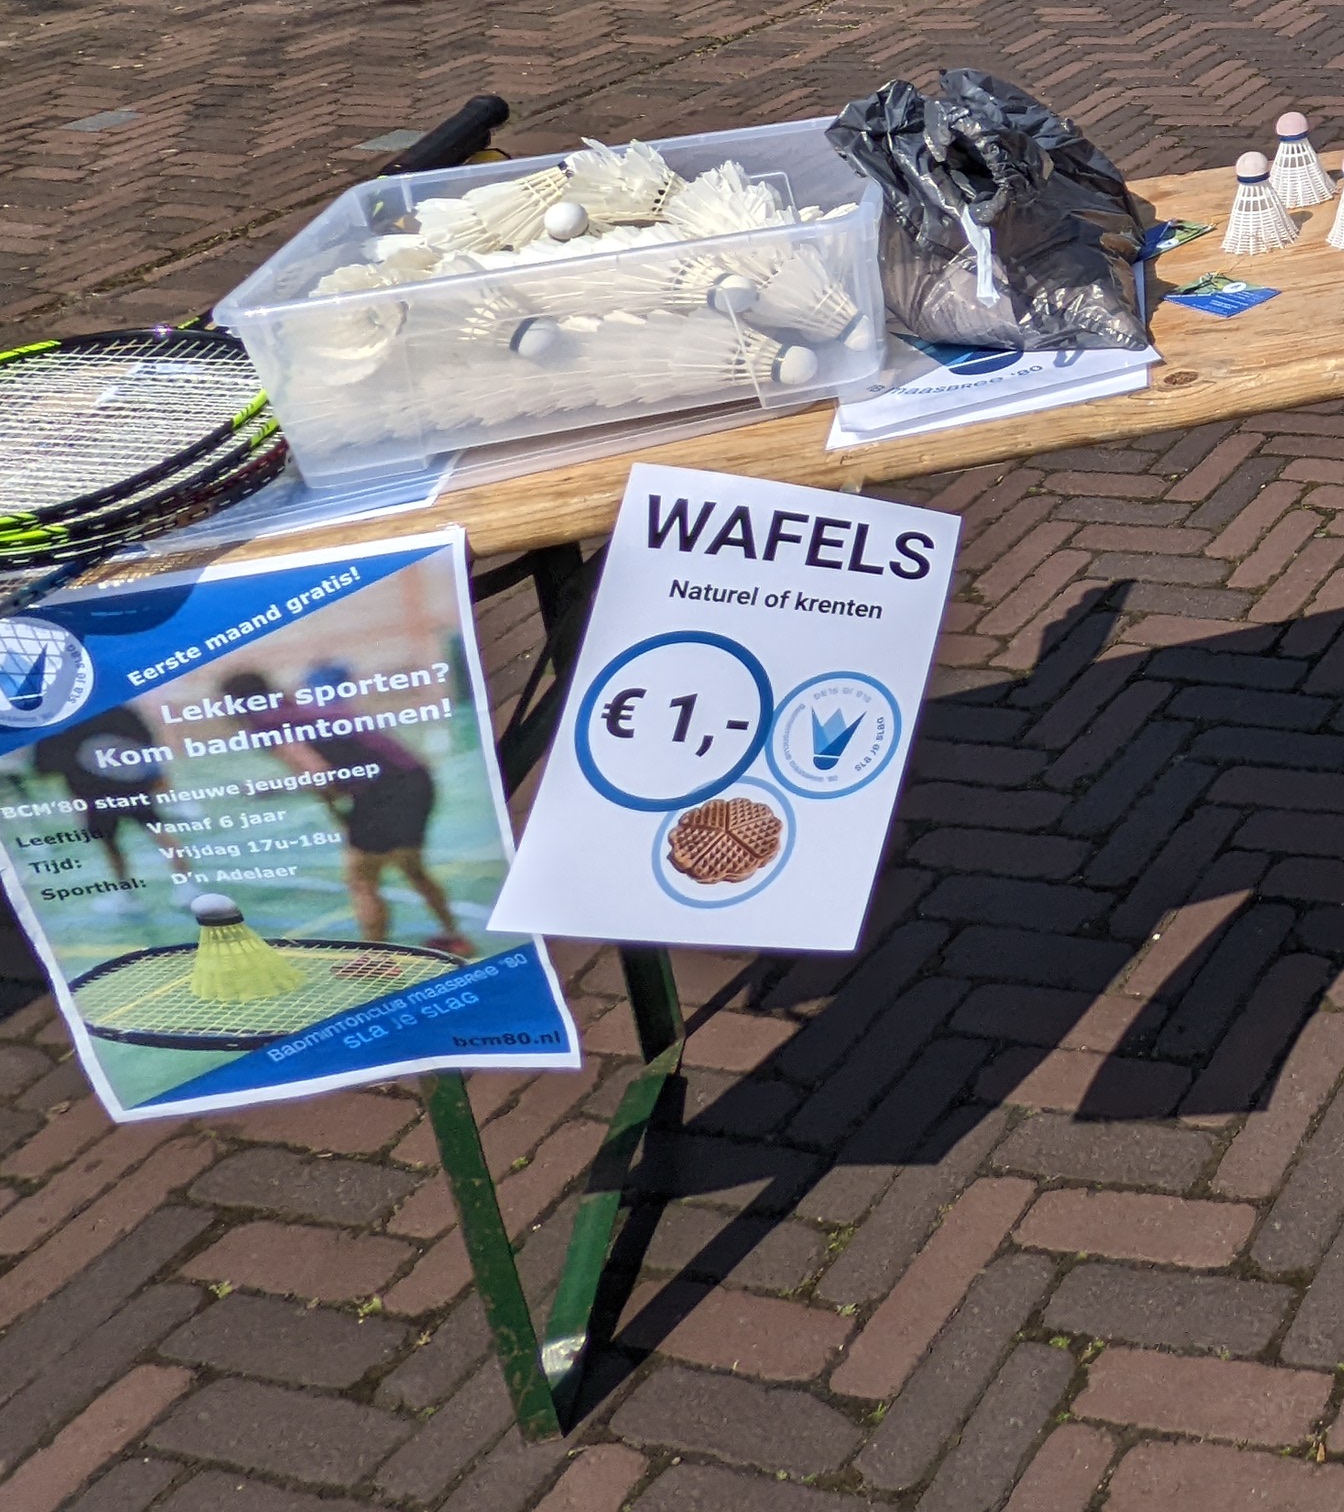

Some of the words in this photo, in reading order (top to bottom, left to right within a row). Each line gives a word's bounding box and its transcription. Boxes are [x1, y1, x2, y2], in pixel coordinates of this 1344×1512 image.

[646, 494, 936, 580] WAFELS
[668, 579, 758, 607] Naturel
[764, 590, 793, 610] of
[794, 592, 884, 620] krenten
[127, 643, 202, 687] Eerste
[205, 605, 282, 650] maand
[286, 566, 361, 615] gratis!
[160, 691, 284, 724] Lekker
[295, 662, 449, 706] sporten?
[600, 687, 647, 738] €
[95, 745, 173, 769] Kom
[185, 698, 453, 758] badmintonnen!
[94, 793, 151, 810] start
[156, 783, 240, 804] nieuwe
[245, 762, 381, 797] jeugdgroep
[147, 818, 212, 835] Vanaf
[219, 815, 234, 829] 6
[240, 808, 288, 830] jaar
[29, 857, 83, 875] Tijd:
[159, 841, 241, 861] Vrijdag
[247, 831, 342, 854] 17u-18u
[40, 877, 148, 903] Sporthal:
[216, 864, 298, 883] Adelaer
[452, 1031, 561, 1049] bcm80.nl
